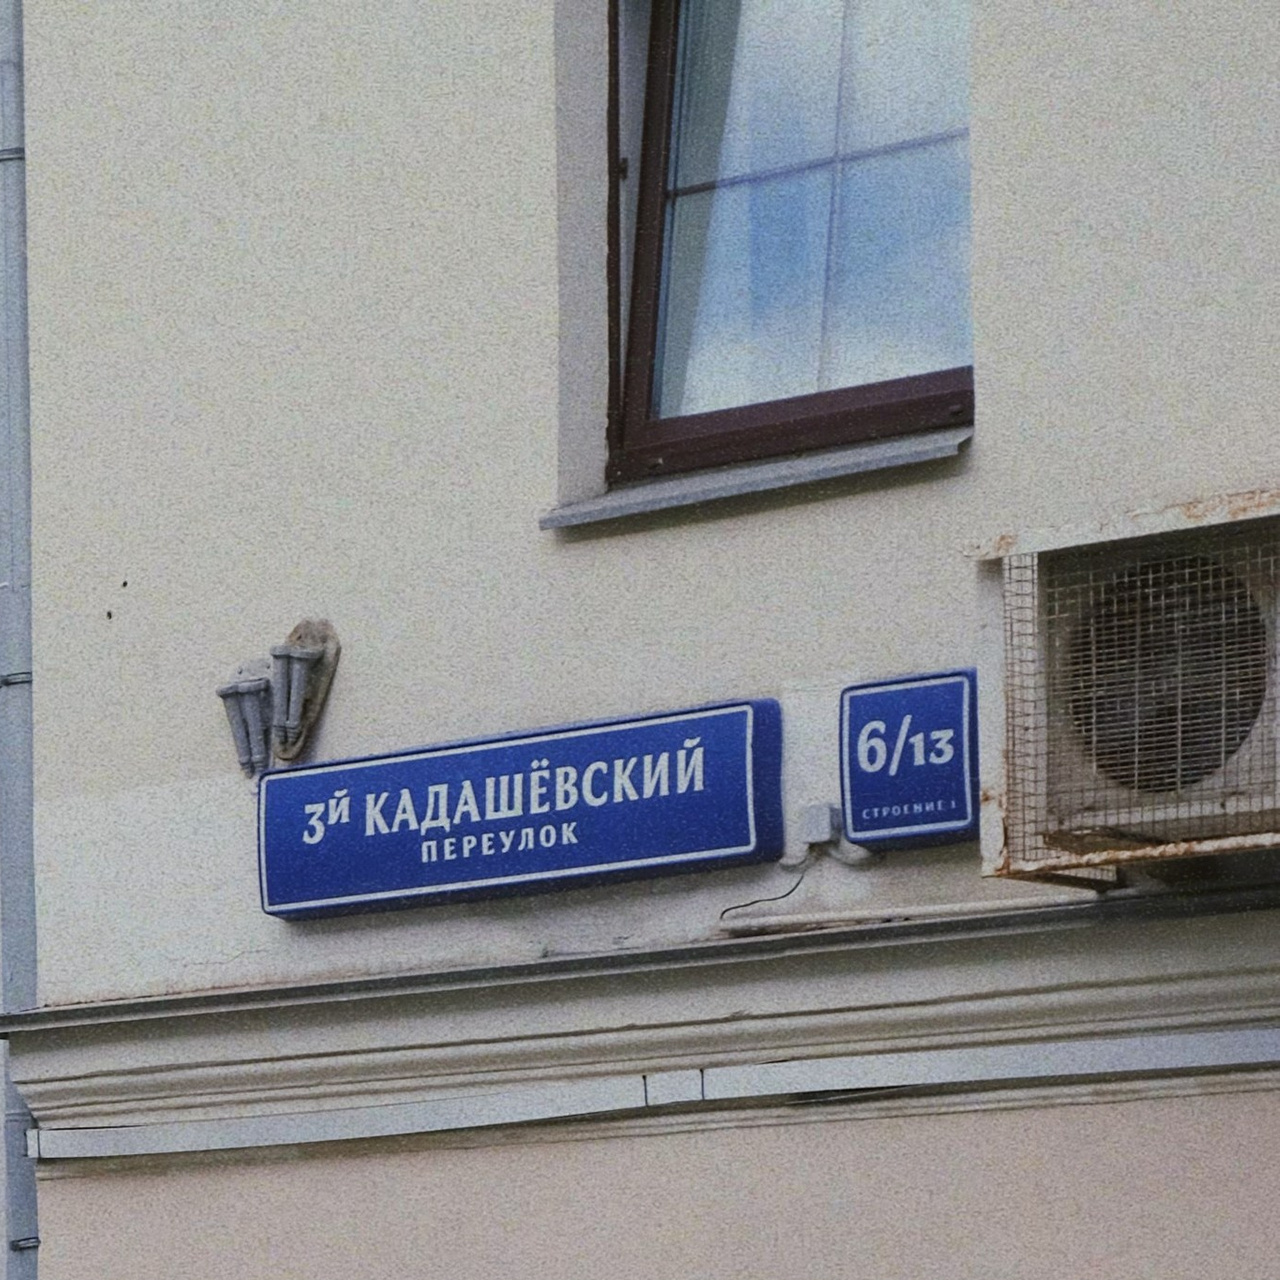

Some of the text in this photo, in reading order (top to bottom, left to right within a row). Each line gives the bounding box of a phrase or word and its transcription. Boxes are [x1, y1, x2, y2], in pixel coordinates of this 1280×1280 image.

[857, 714, 955, 776] 6/13
[364, 736, 705, 836] КАДАШЁВСКИЙ
[862, 800, 943, 820] СТРОЕНИЕ
[421, 821, 579, 863] ПЕРЕУЛОК
